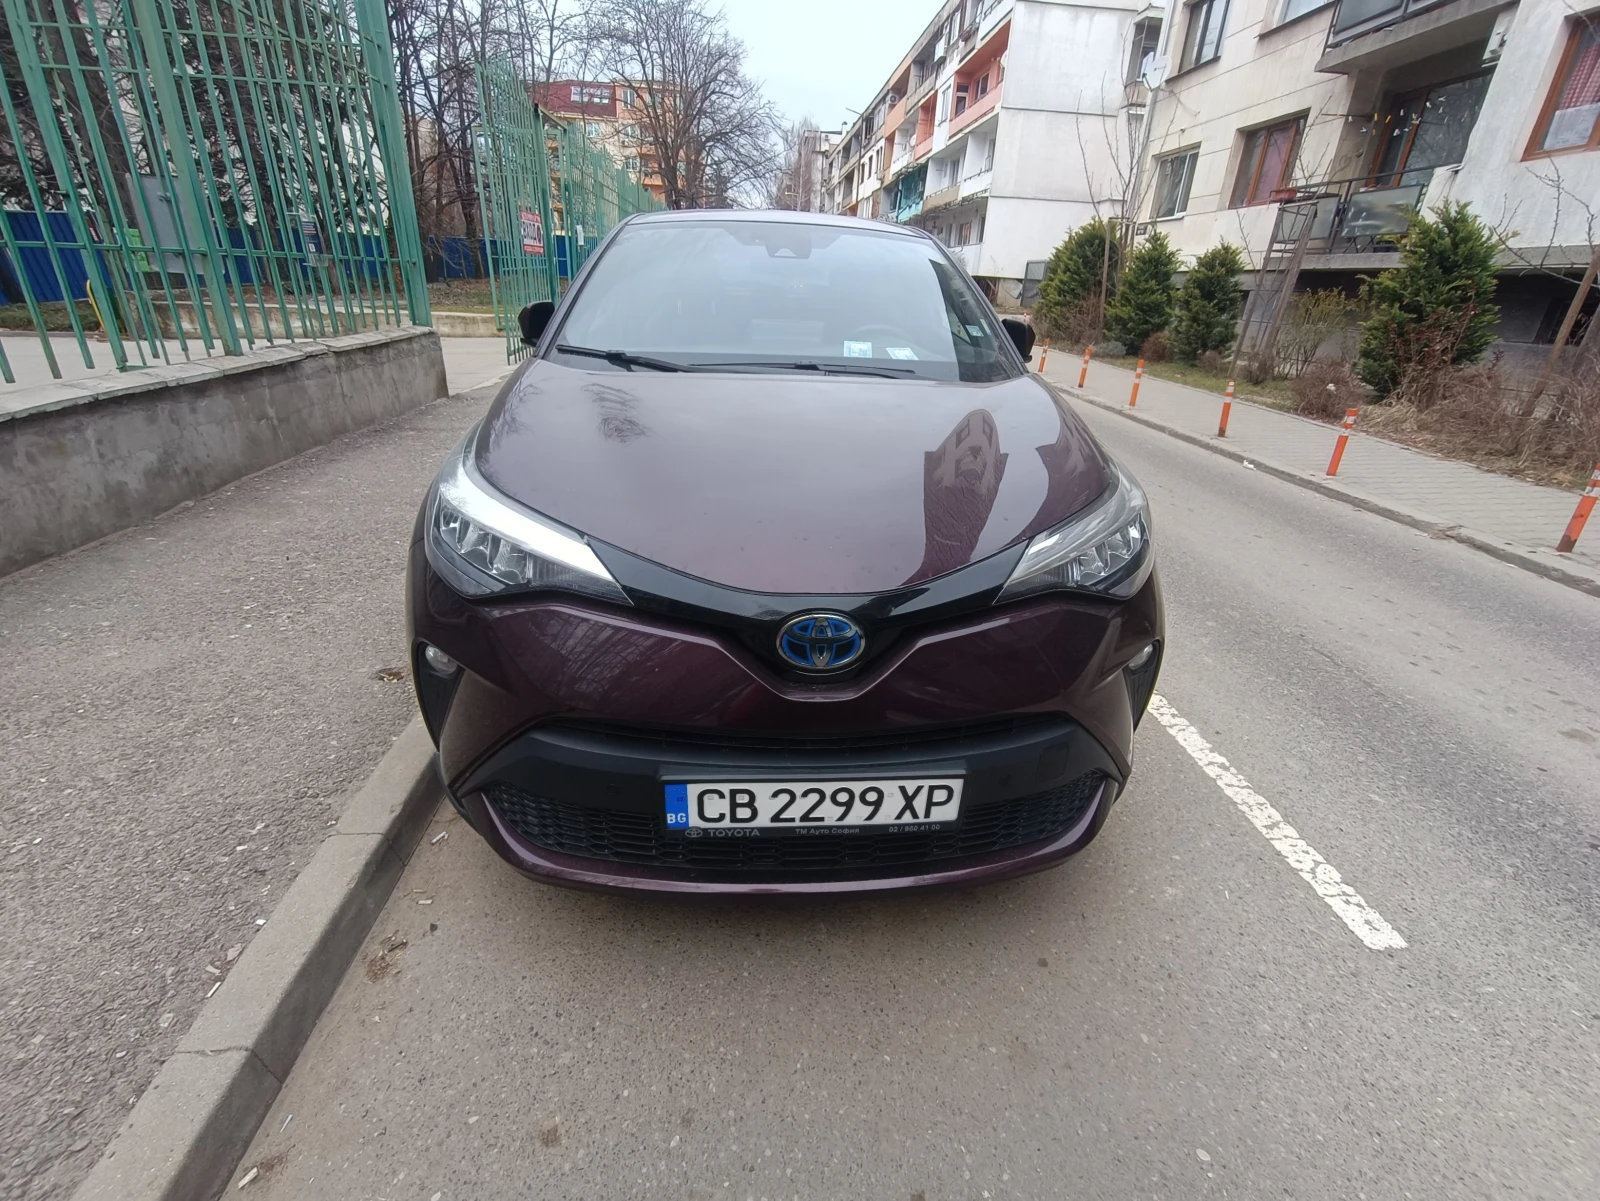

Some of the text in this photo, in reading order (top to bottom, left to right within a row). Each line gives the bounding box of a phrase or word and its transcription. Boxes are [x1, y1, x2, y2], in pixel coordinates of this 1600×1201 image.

[769, 786, 885, 823] 2299
[666, 813, 687, 824] BG
[708, 828, 760, 837] TOYOTA
[809, 828, 830, 836] Ауто
[831, 827, 860, 835] София
